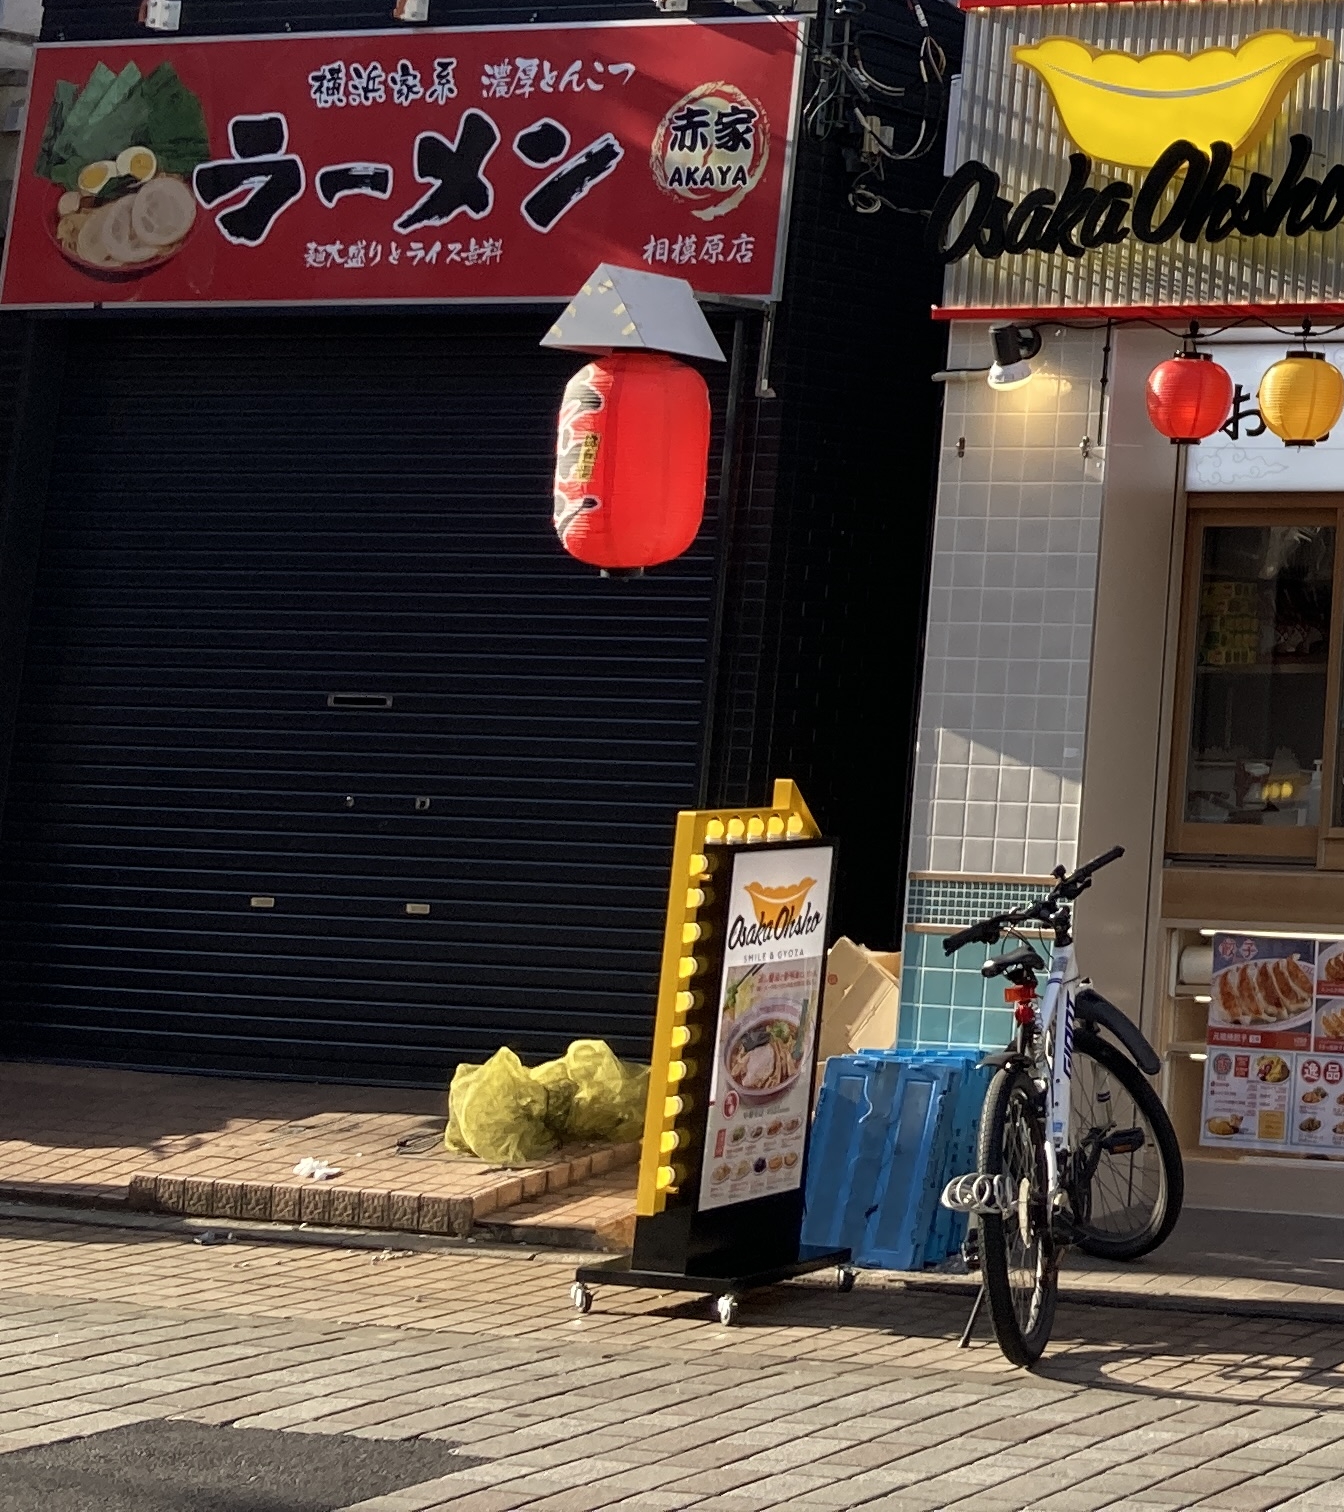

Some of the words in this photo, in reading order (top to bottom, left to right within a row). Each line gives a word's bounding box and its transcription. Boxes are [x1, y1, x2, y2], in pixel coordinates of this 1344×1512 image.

[308, 58, 460, 108] 横浜家系
[480, 57, 636, 99] 濃厚とんこつ
[669, 103, 759, 153] 赤家
[195, 107, 626, 246] ラーメン
[667, 165, 749, 188] AKAYA
[928, 157, 1133, 262] Osaka
[643, 234, 756, 265] 相模原店
[728, 911, 772, 950] Osaka
[772, 902, 823, 940] Ohsho
[743, 951, 767, 963] SMILE
[777, 948, 804, 960] GYOZA
